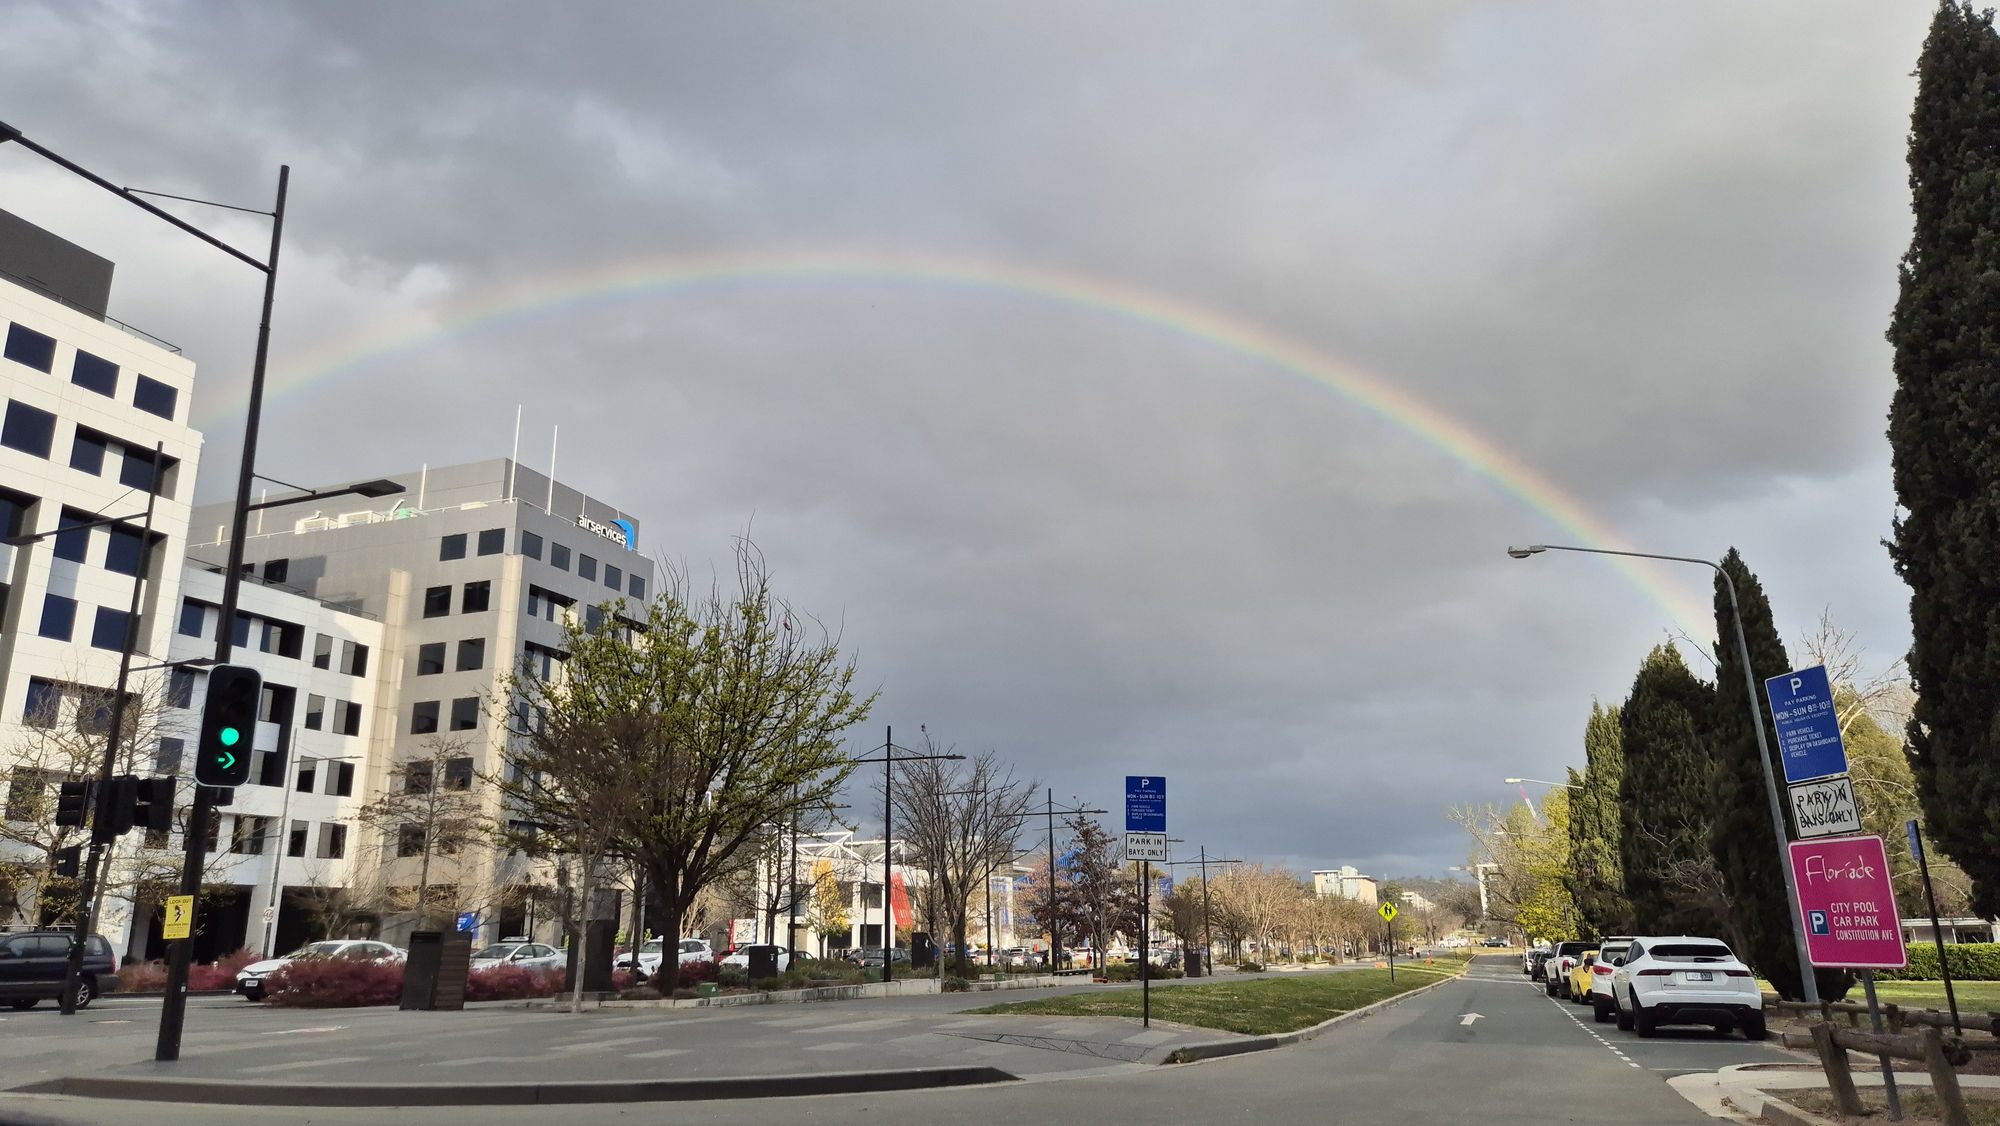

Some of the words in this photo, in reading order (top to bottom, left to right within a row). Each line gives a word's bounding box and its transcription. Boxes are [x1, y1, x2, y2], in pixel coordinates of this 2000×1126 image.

[579, 514, 627, 545] airservices
[1790, 677, 1802, 695] P
[1796, 694, 1817, 704] PARKING
[1797, 726, 1814, 735] VEHICLE
[1790, 750, 1807, 758] VEHICLE
[1141, 779, 1150, 789] P
[1798, 790, 1829, 807] PARK
[1130, 838, 1151, 846] PARK
[1128, 848, 1145, 856] BAYS
[1147, 849, 1164, 857] ONLY
[1830, 902, 1850, 914] CITY
[1853, 901, 1879, 913] POOL
[1811, 912, 1825, 933] P
[1833, 916, 1852, 927] CAR
[1854, 915, 1880, 927] PARK
[1835, 929, 1880, 941] CONSTITUTION
[1881, 929, 1895, 941] AVE
